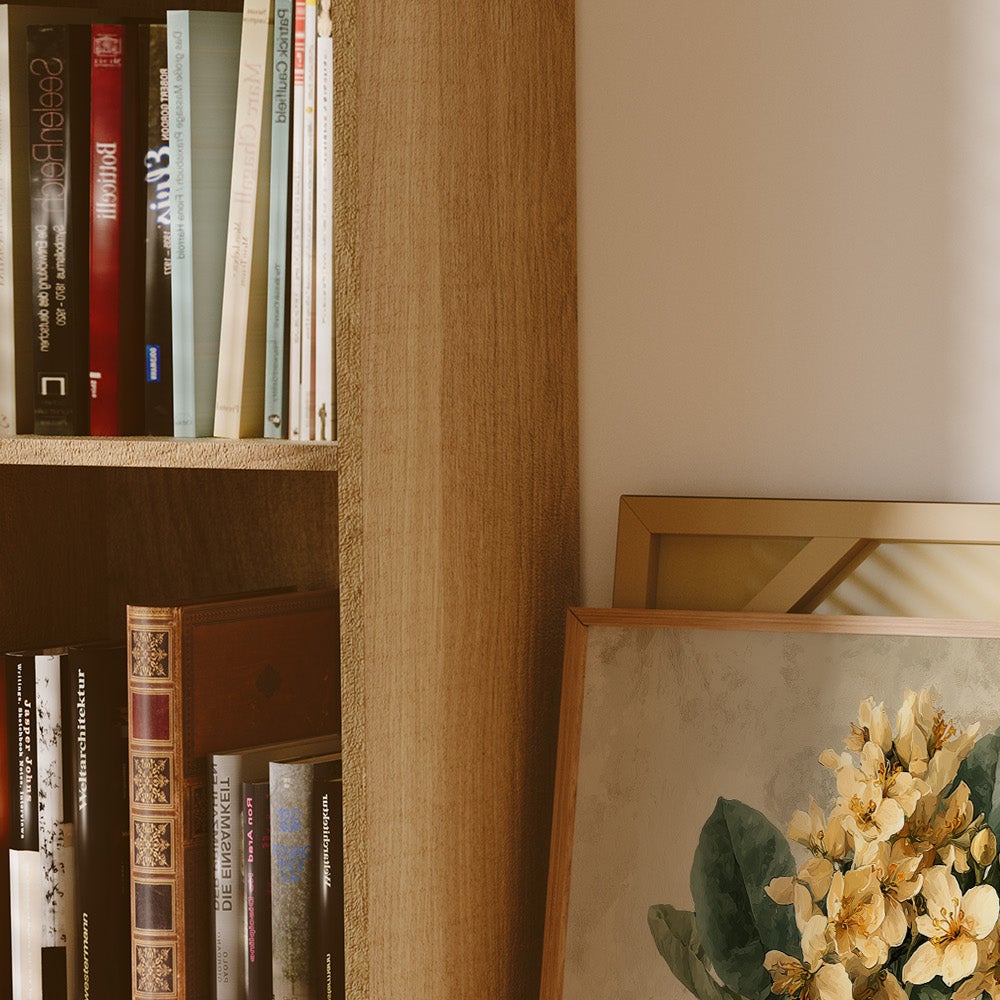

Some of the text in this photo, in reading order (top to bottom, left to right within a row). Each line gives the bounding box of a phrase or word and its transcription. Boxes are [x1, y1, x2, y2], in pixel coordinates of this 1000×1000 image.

[23, 699, 34, 804] Jasper Johns
[76, 668, 88, 812] Weltarchitektur
